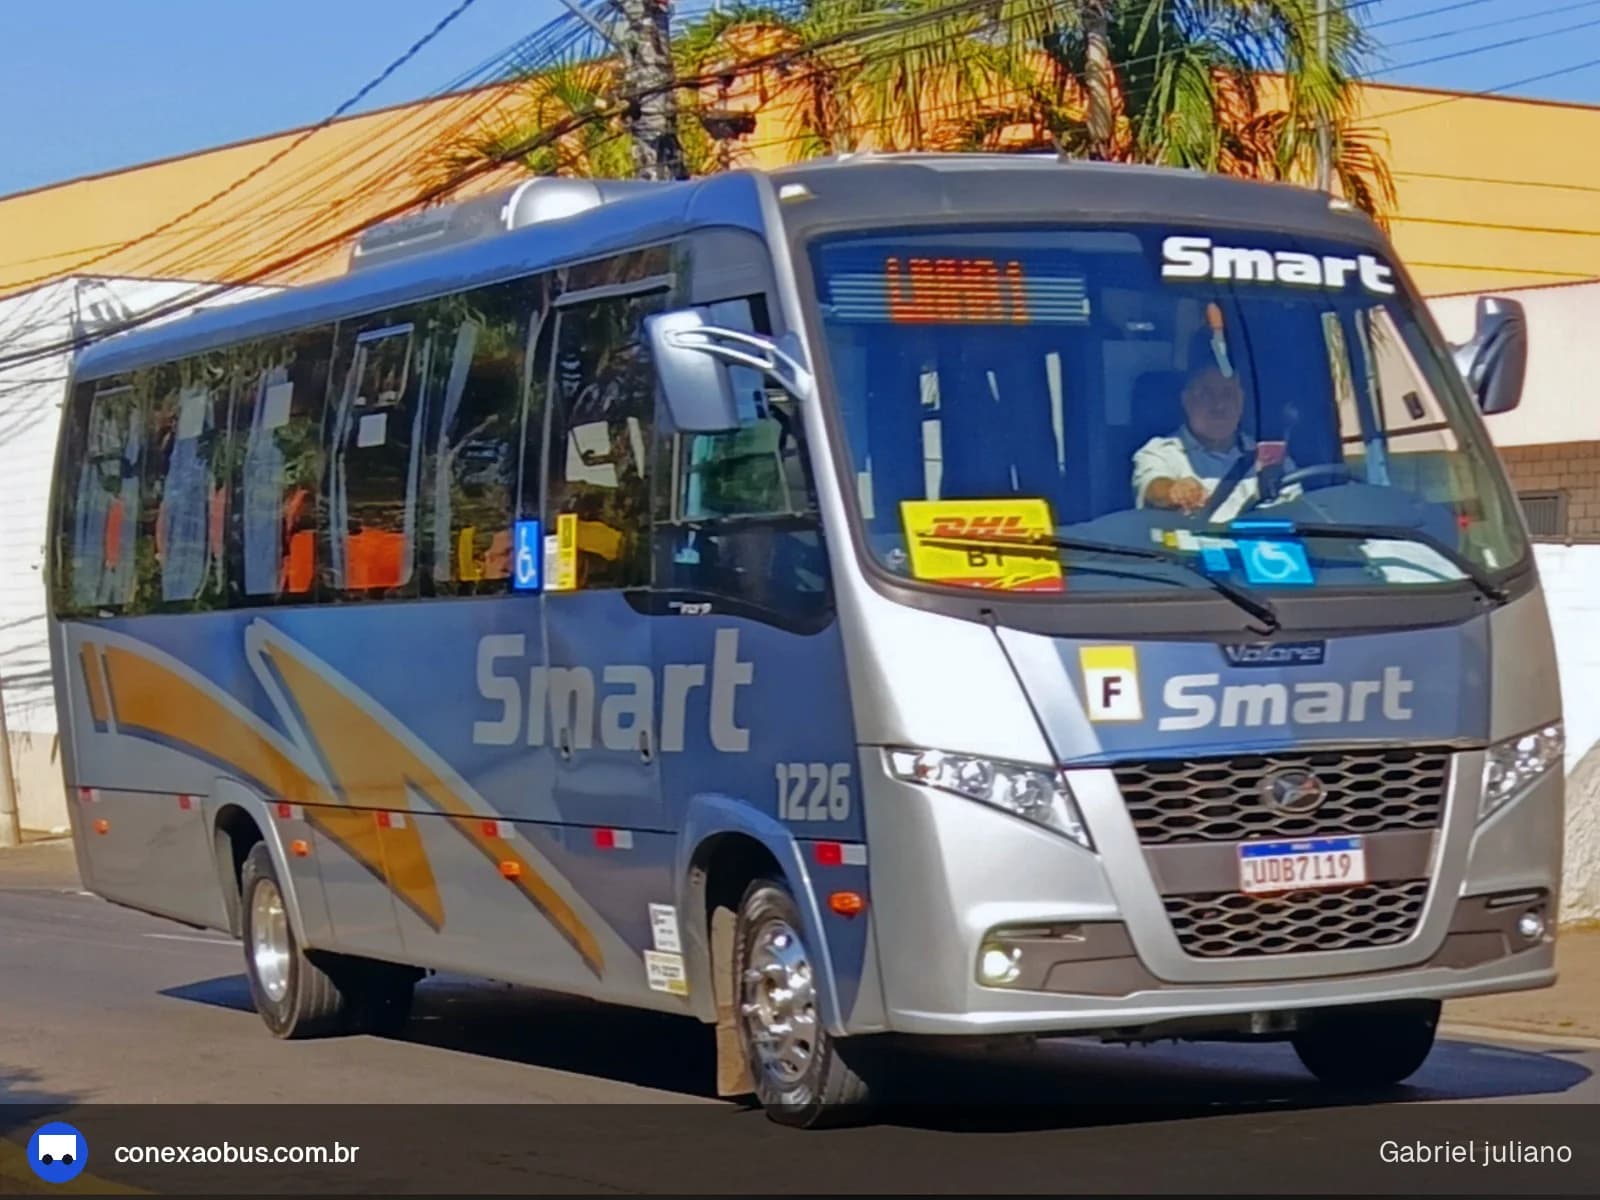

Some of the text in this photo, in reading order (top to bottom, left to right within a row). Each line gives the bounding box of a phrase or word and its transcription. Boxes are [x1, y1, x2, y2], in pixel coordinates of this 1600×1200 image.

[1161, 235, 1396, 294] Smart
[932, 516, 1027, 537] DHL
[472, 628, 754, 753] Smart
[1102, 676, 1122, 708] F
[1158, 666, 1415, 732] Smart
[776, 762, 851, 821] 1226
